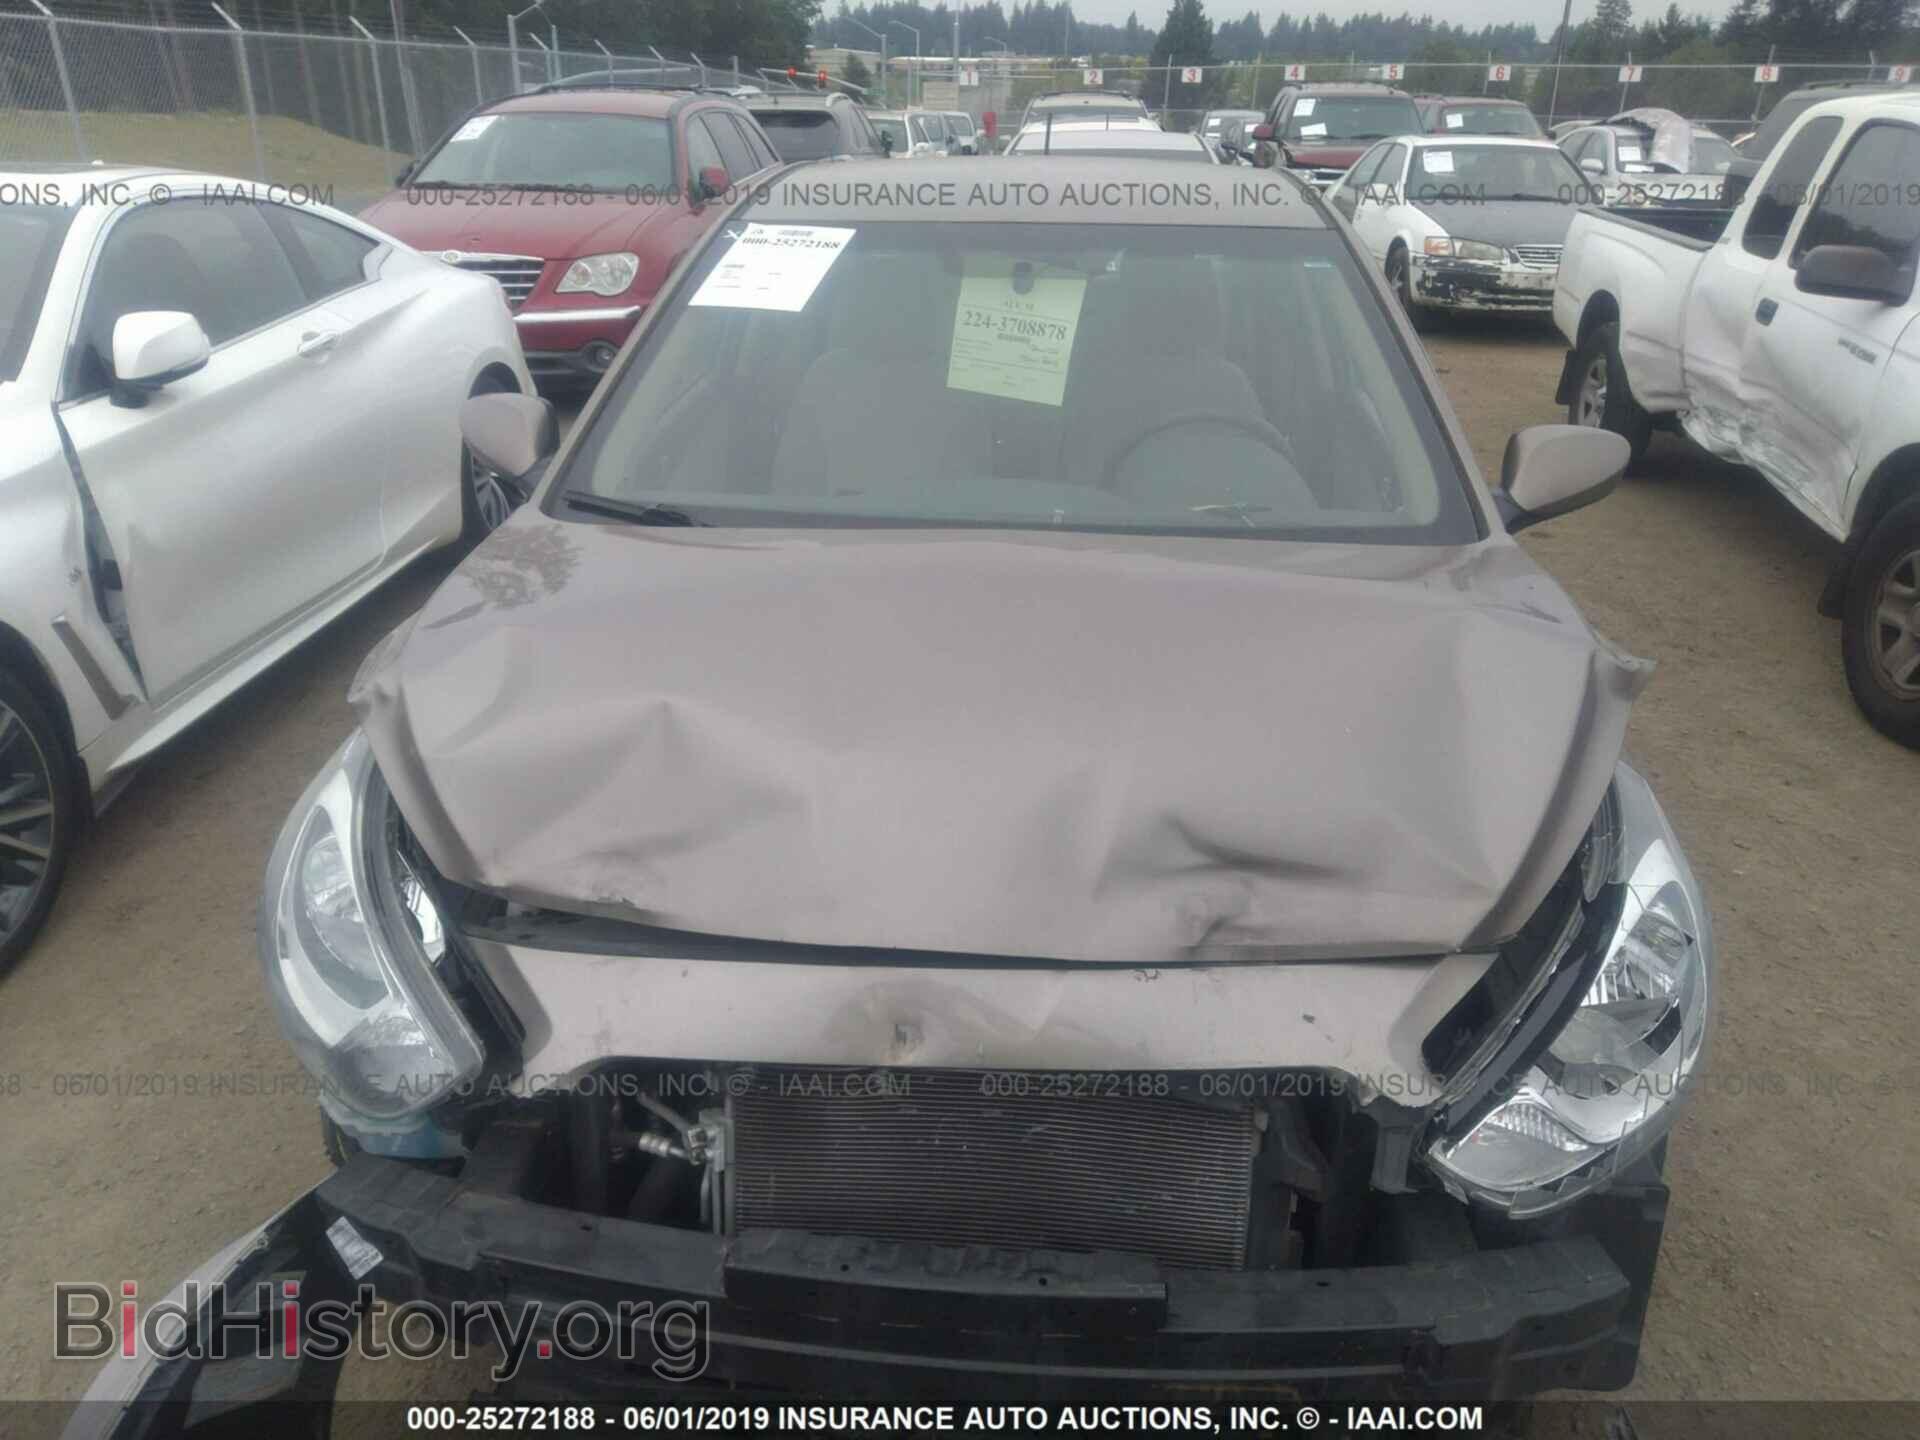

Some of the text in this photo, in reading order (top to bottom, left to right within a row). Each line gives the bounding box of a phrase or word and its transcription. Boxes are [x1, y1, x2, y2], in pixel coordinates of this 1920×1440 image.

[966, 69, 974, 84] 1
[1088, 70, 1098, 83] 2
[1187, 68, 1197, 82] 3
[1289, 65, 1300, 79] 4
[1387, 64, 1398, 79] 5
[1495, 65, 1506, 80] 6
[1625, 66, 1636, 81] 7
[1761, 65, 1772, 81] 8
[1894, 65, 1905, 81] 9
[742, 236, 841, 250] 000-25272188
[962, 310, 1068, 342] 224-3708878
